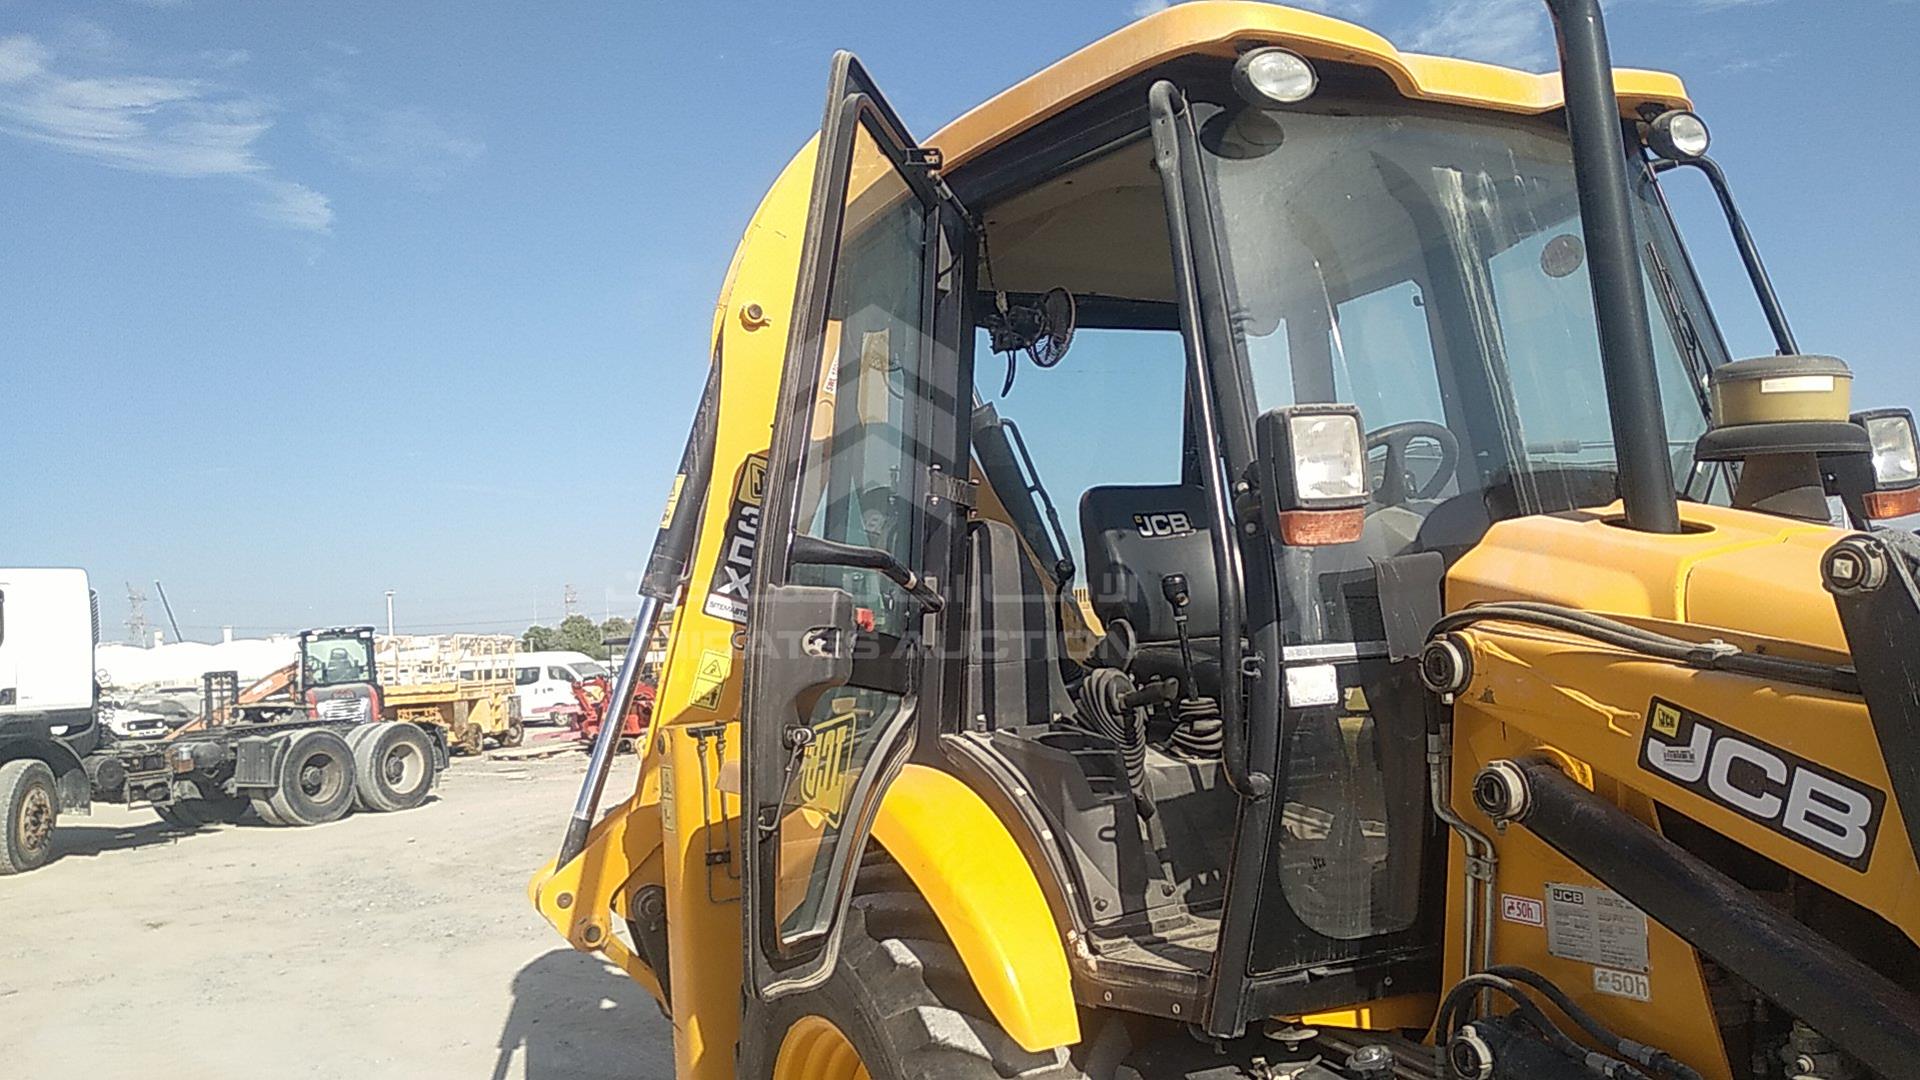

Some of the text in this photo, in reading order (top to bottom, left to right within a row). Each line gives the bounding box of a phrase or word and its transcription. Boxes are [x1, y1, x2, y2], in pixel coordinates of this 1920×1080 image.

[1138, 513, 1191, 536] JCB
[1657, 709, 1675, 728] JCB
[1647, 722, 1872, 859] JCB
[1554, 890, 1584, 904] JCB
[1516, 902, 1534, 920] 50h
[1611, 973, 1648, 997] 50h
